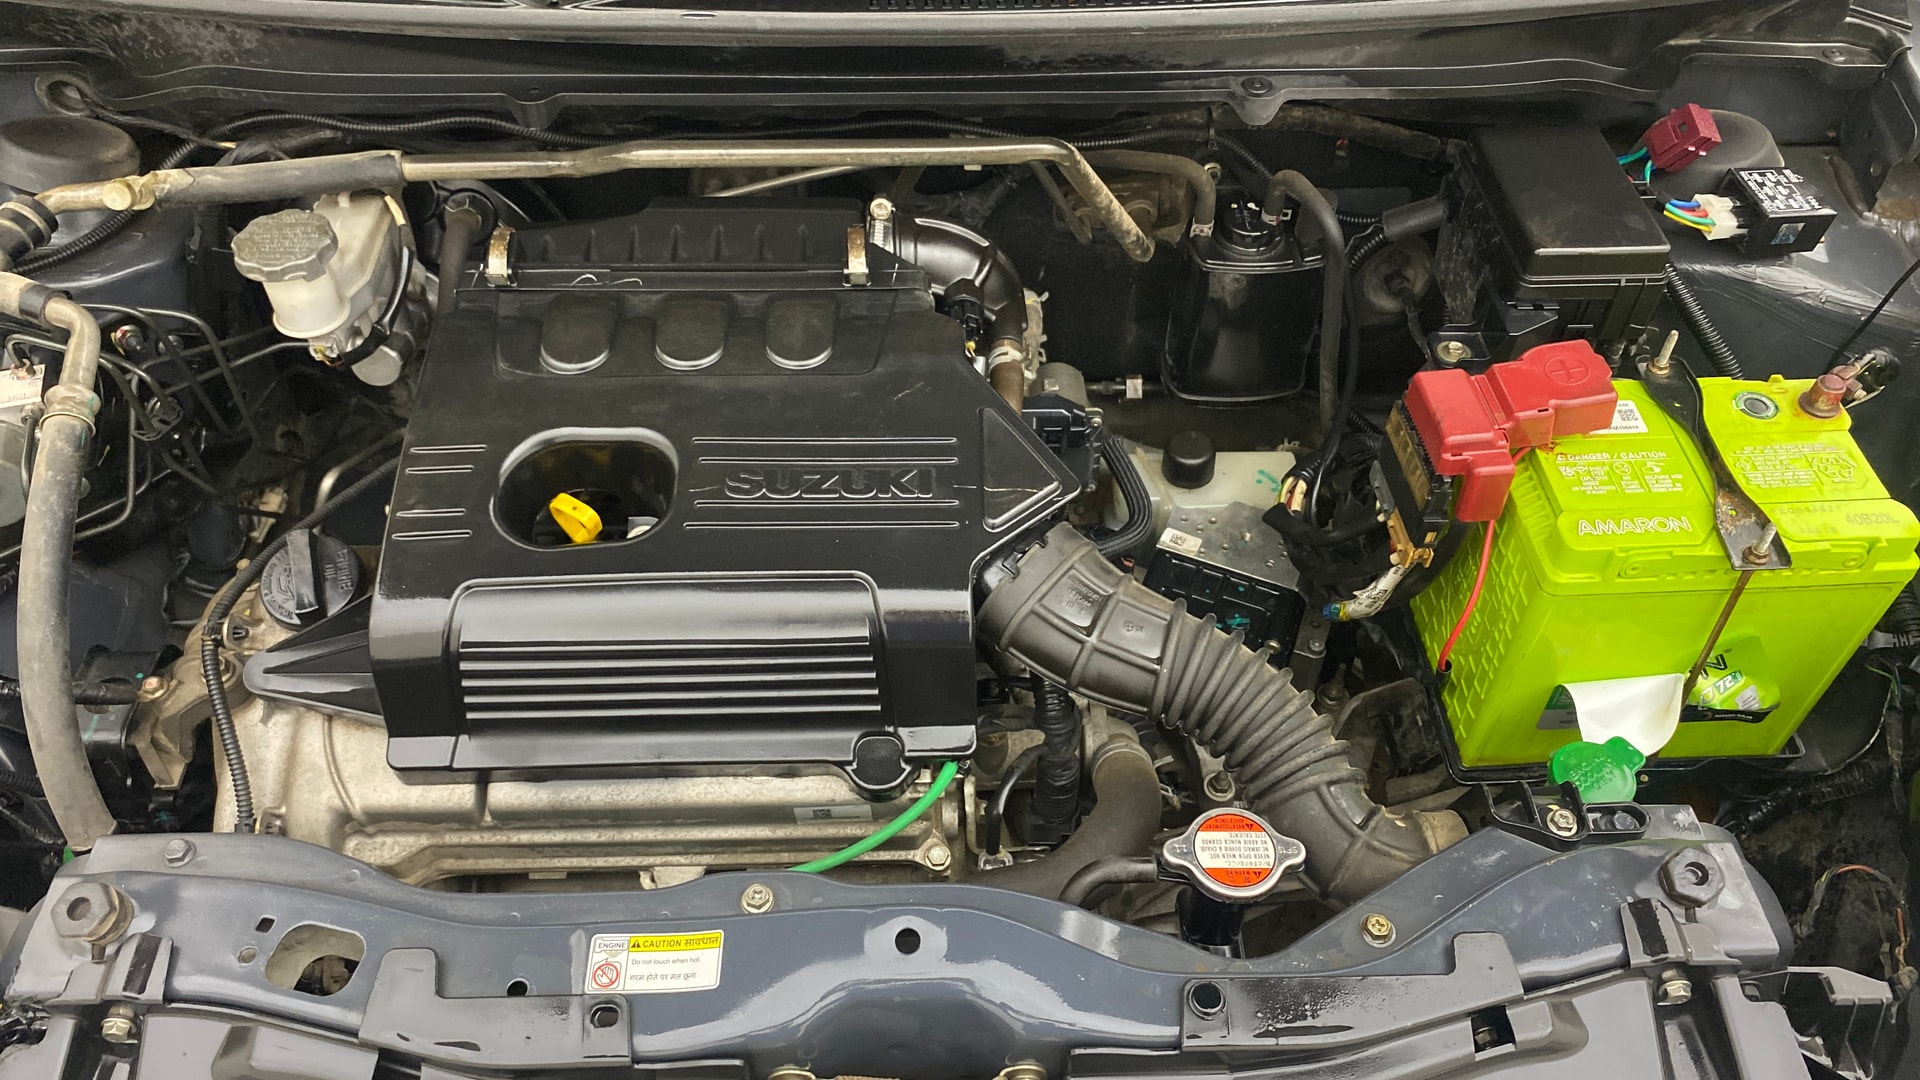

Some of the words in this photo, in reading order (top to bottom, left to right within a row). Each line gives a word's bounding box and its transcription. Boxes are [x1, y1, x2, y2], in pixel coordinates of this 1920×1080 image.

[725, 467, 934, 498] SUZUKI
[1578, 516, 1693, 536] AMARON
[643, 939, 682, 948] CAUTION
[684, 936, 719, 947] सावधान
